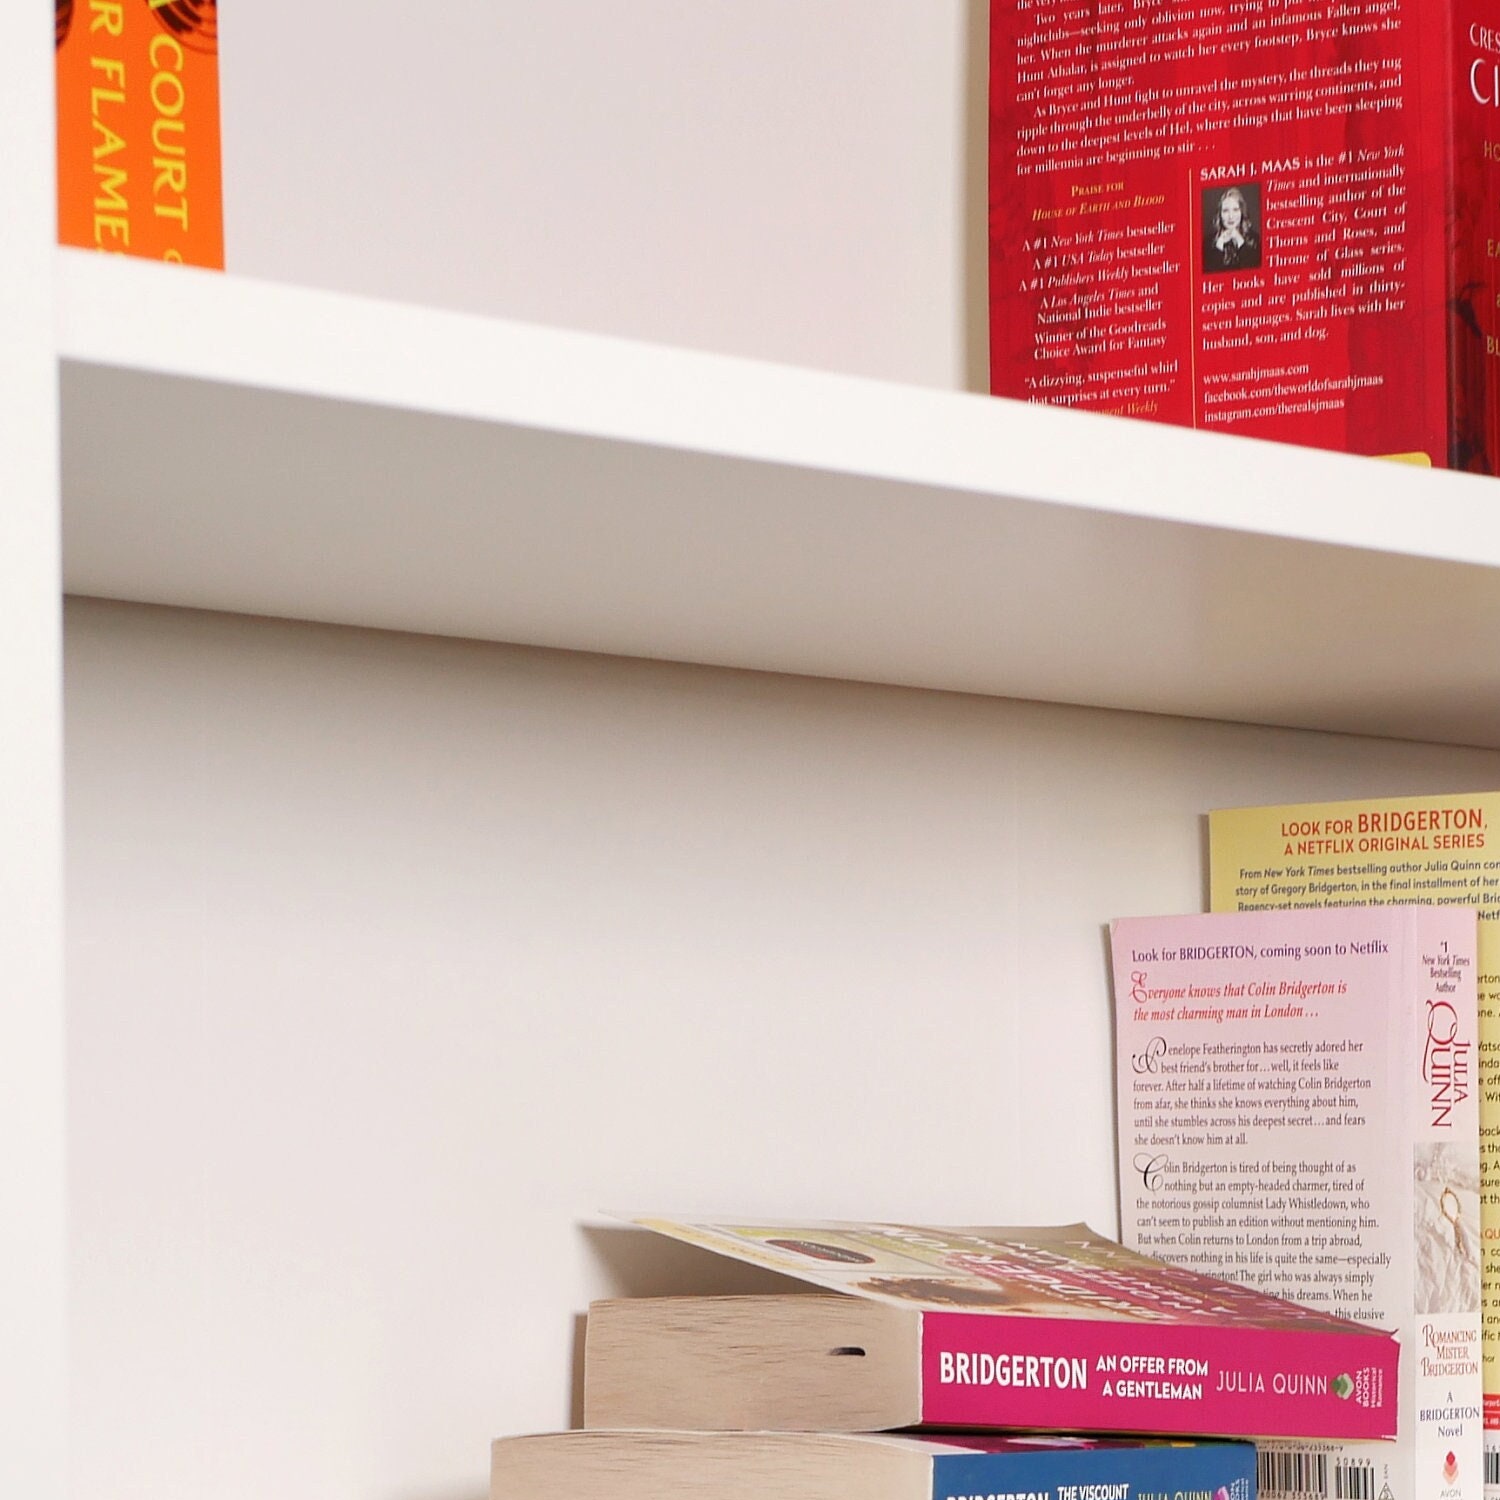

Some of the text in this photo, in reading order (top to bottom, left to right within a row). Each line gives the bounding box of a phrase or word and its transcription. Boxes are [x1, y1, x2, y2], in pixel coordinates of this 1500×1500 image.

[149, 33, 189, 232] COURT
[90, 56, 130, 257] FLAME
[1200, 163, 1246, 181] SARAH
[1261, 156, 1301, 174] MAAS
[1203, 363, 1309, 386] www.sarahjmaas.com
[1281, 808, 1488, 837] LOOK FOR BRIDGERTON,
[1284, 832, 1485, 857] A NETFLIX ORIGINAL SERIES
[1239, 867, 1263, 880] From
[1263, 866, 1284, 879] New
[1285, 865, 1306, 879] York
[1307, 865, 1335, 878] Times
[1336, 862, 1388, 877] bestselling
[1389, 860, 1422, 874] author
[1423, 859, 1449, 873] Julia
[1450, 858, 1481, 873] Quinn
[1131, 939, 1389, 963] Look for BRIDGERTON, coming soon to Netflix
[1129, 971, 1348, 1004] Everyone knows that Colin Bridgerton is
[1133, 1006, 1150, 1022] the
[1151, 1007, 1175, 1021] most
[1176, 1004, 1225, 1025] charming
[1226, 1006, 1249, 1019] man
[1250, 1003, 1262, 1019] in
[1422, 999, 1458, 1128] QUINN
[1450, 1024, 1471, 1104] JULIA
[1421, 1323, 1477, 1347] ROMANCING
[1436, 1346, 1470, 1360] MISTER
[940, 1351, 1087, 1390] BRIDGERTON
[1095, 1354, 1209, 1377] AN OFFER FROM
[1421, 1357, 1479, 1378] BRIDGERTON
[1102, 1378, 1202, 1401] A GENTLEMAN
[1216, 1369, 1327, 1396] JULIA QUINN
[1447, 1391, 1453, 1403] A
[1419, 1407, 1480, 1422] BRIDGERTON
[1437, 1424, 1463, 1438] Novel
